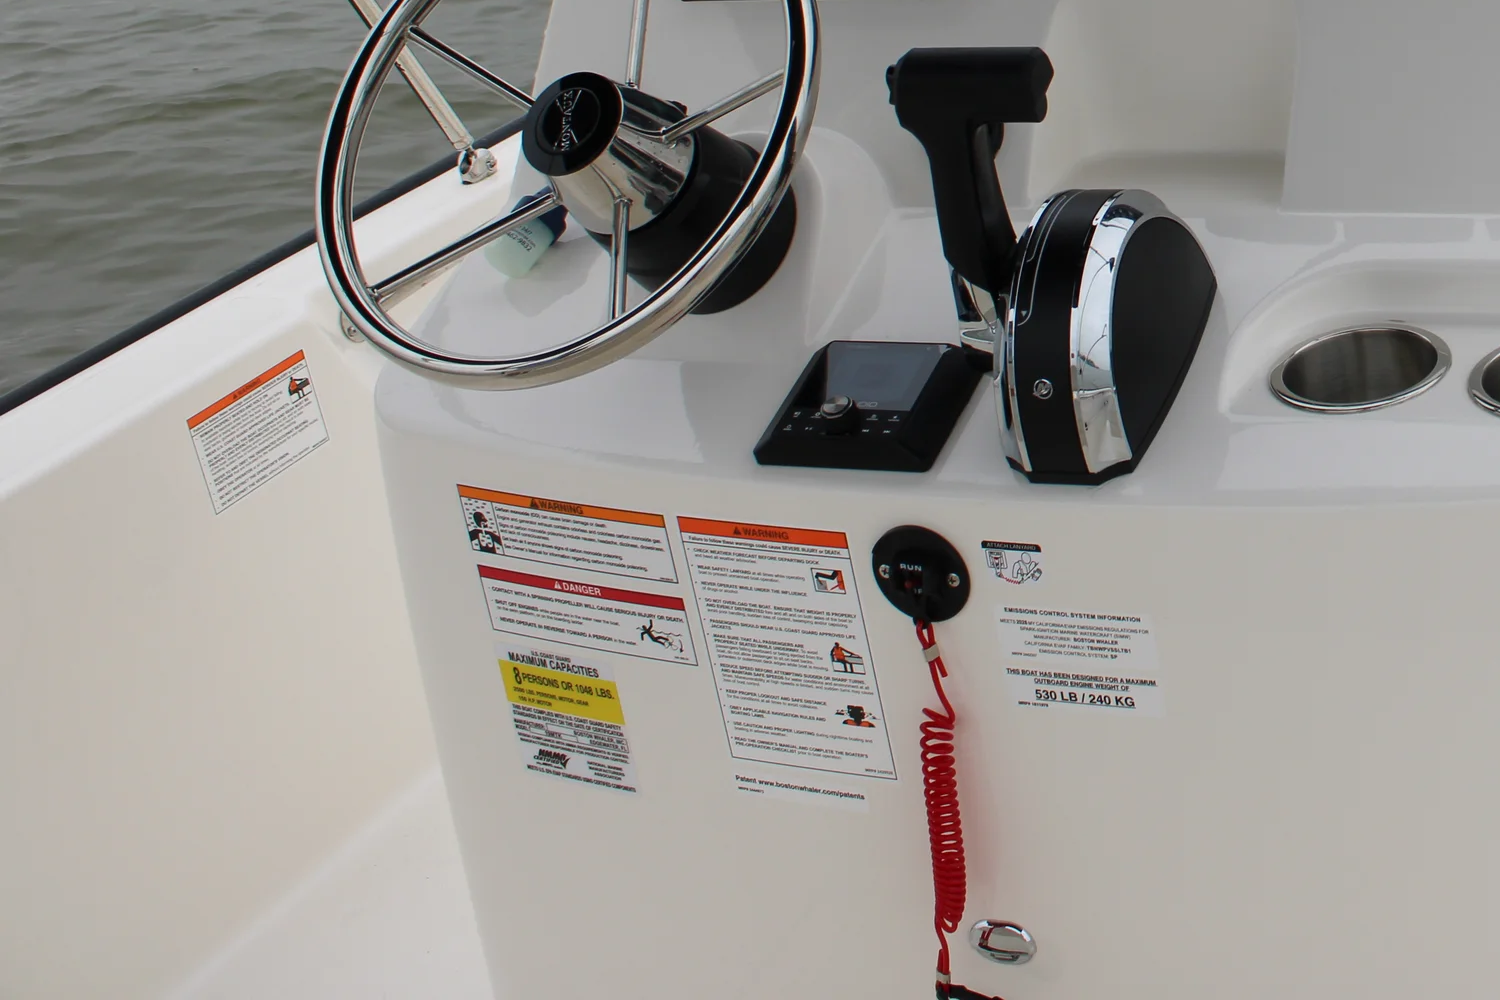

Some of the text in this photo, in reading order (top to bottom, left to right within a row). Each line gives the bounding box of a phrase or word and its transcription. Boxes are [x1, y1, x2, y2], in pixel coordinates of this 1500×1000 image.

[561, 90, 574, 152] MONTAUK
[538, 499, 584, 515] WARNING
[742, 527, 790, 540] WARNING
[900, 563, 922, 572] RUN
[562, 581, 602, 596] DANGER
[1004, 606, 1141, 623] EMISSIONS CONTROL SYSTEM INFORMATION
[540, 652, 555, 660] COAST
[508, 651, 600, 678] MAXIMUM CAPACITIES
[513, 666, 615, 700] 8 PERSONS OR 1048 LBS.
[1006, 667, 1020, 675] THIS
[1039, 670, 1053, 678] HAS
[1072, 673, 1104, 682] DESIGNED
[1125, 678, 1156, 687] MAXIMUM
[1034, 678, 1069, 687] OUTBOARD
[1070, 681, 1093, 689] ENGINE
[1095, 683, 1119, 691] WEIGHT
[1035, 689, 1136, 707] 530 LB / 240 KG
[735, 774, 757, 784] Patent
